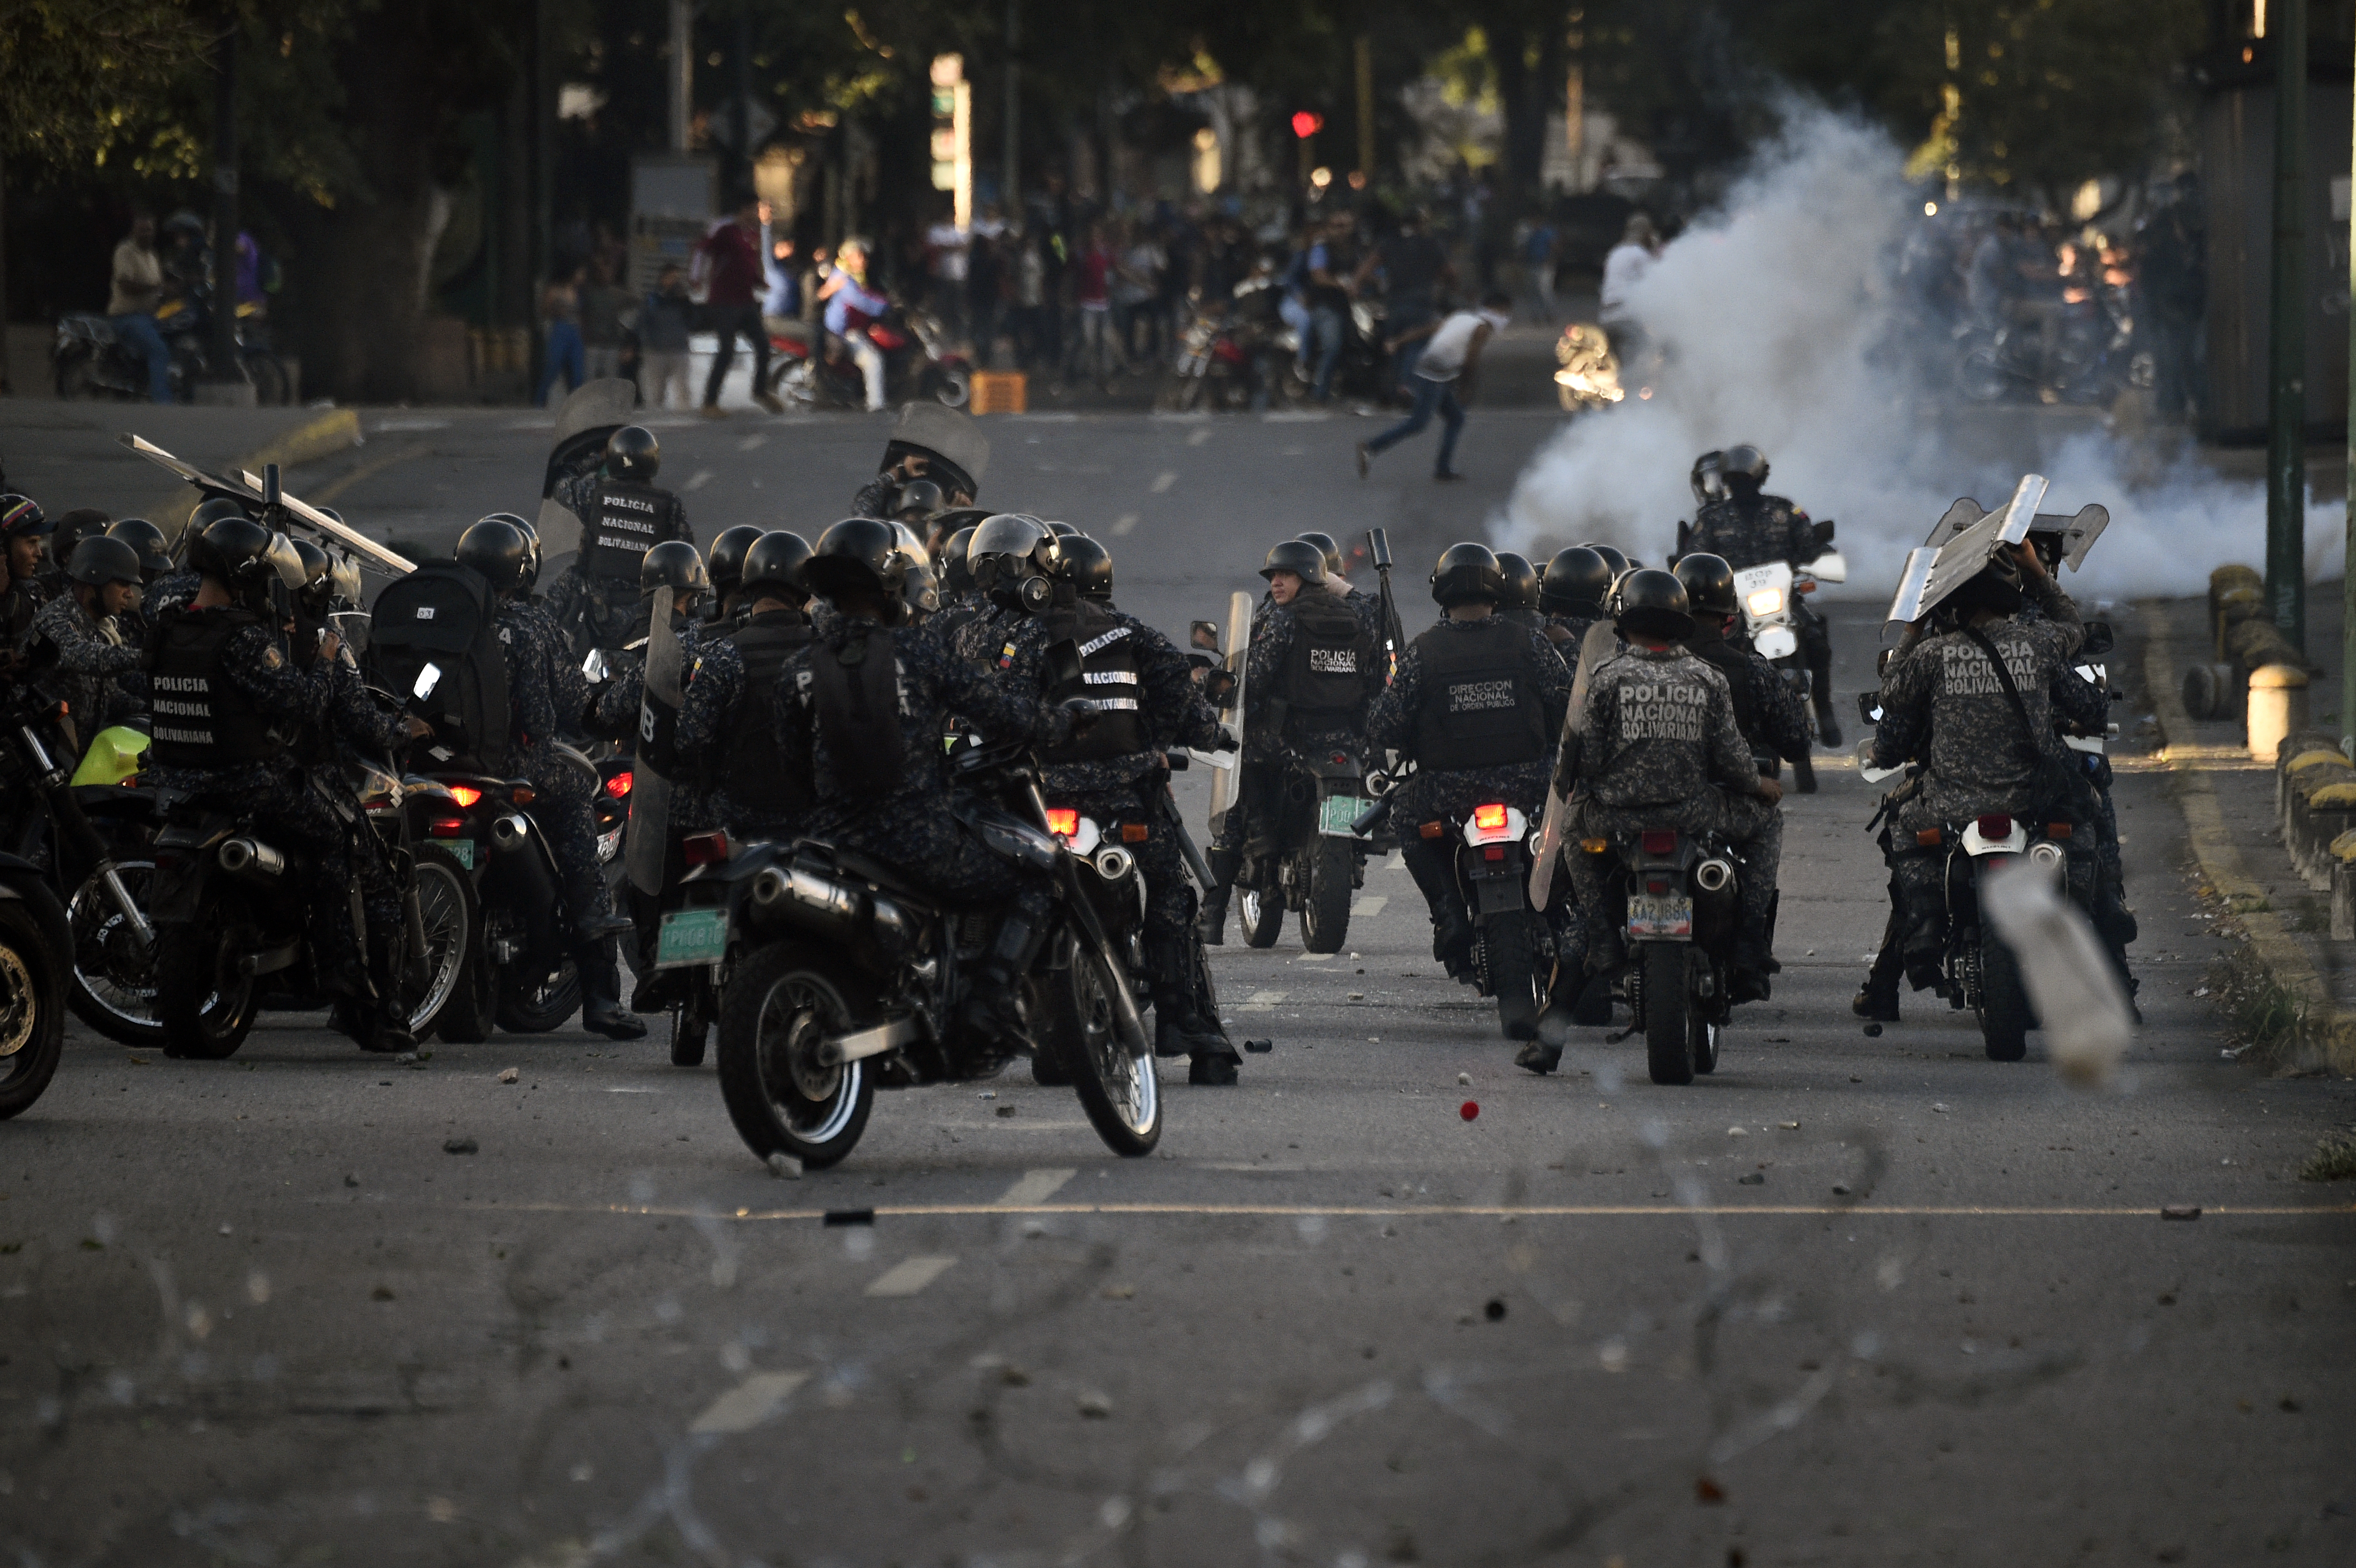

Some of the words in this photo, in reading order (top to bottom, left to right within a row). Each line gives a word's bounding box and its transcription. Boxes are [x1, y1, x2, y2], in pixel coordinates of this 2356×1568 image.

[603, 496, 654, 513] POLICIA
[602, 516, 654, 534] NACIONAL
[1079, 627, 1132, 657] POLICIA
[154, 677, 208, 692] POLICIA
[1455, 691, 1508, 703] NACIONAL
[153, 699, 210, 716] NACIONAL
[1462, 702, 1484, 711] ORDEN
[153, 726, 213, 744] BOLIVARIANA
